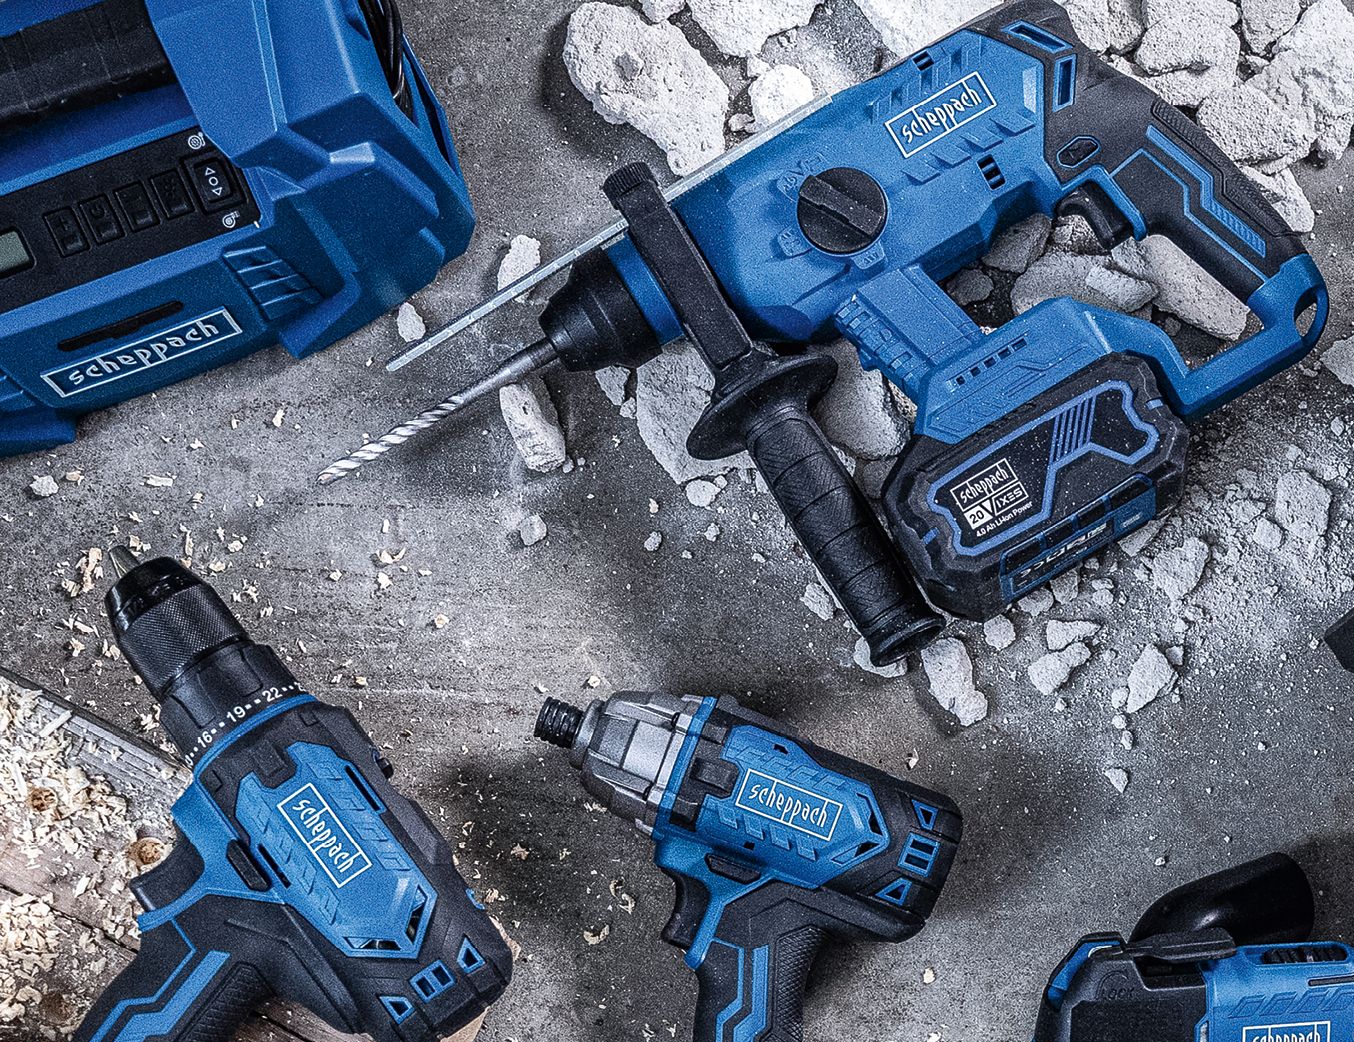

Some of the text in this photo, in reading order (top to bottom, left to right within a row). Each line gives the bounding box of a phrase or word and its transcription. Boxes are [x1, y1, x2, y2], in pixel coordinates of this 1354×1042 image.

[902, 80, 982, 144] scheppach
[67, 315, 219, 386] scheppach
[960, 463, 1009, 503] scheppach
[1012, 501, 1033, 516] Power
[197, 687, 283, 748] 16 19 22
[749, 780, 828, 829] scheppach
[292, 799, 359, 873] scheppach
